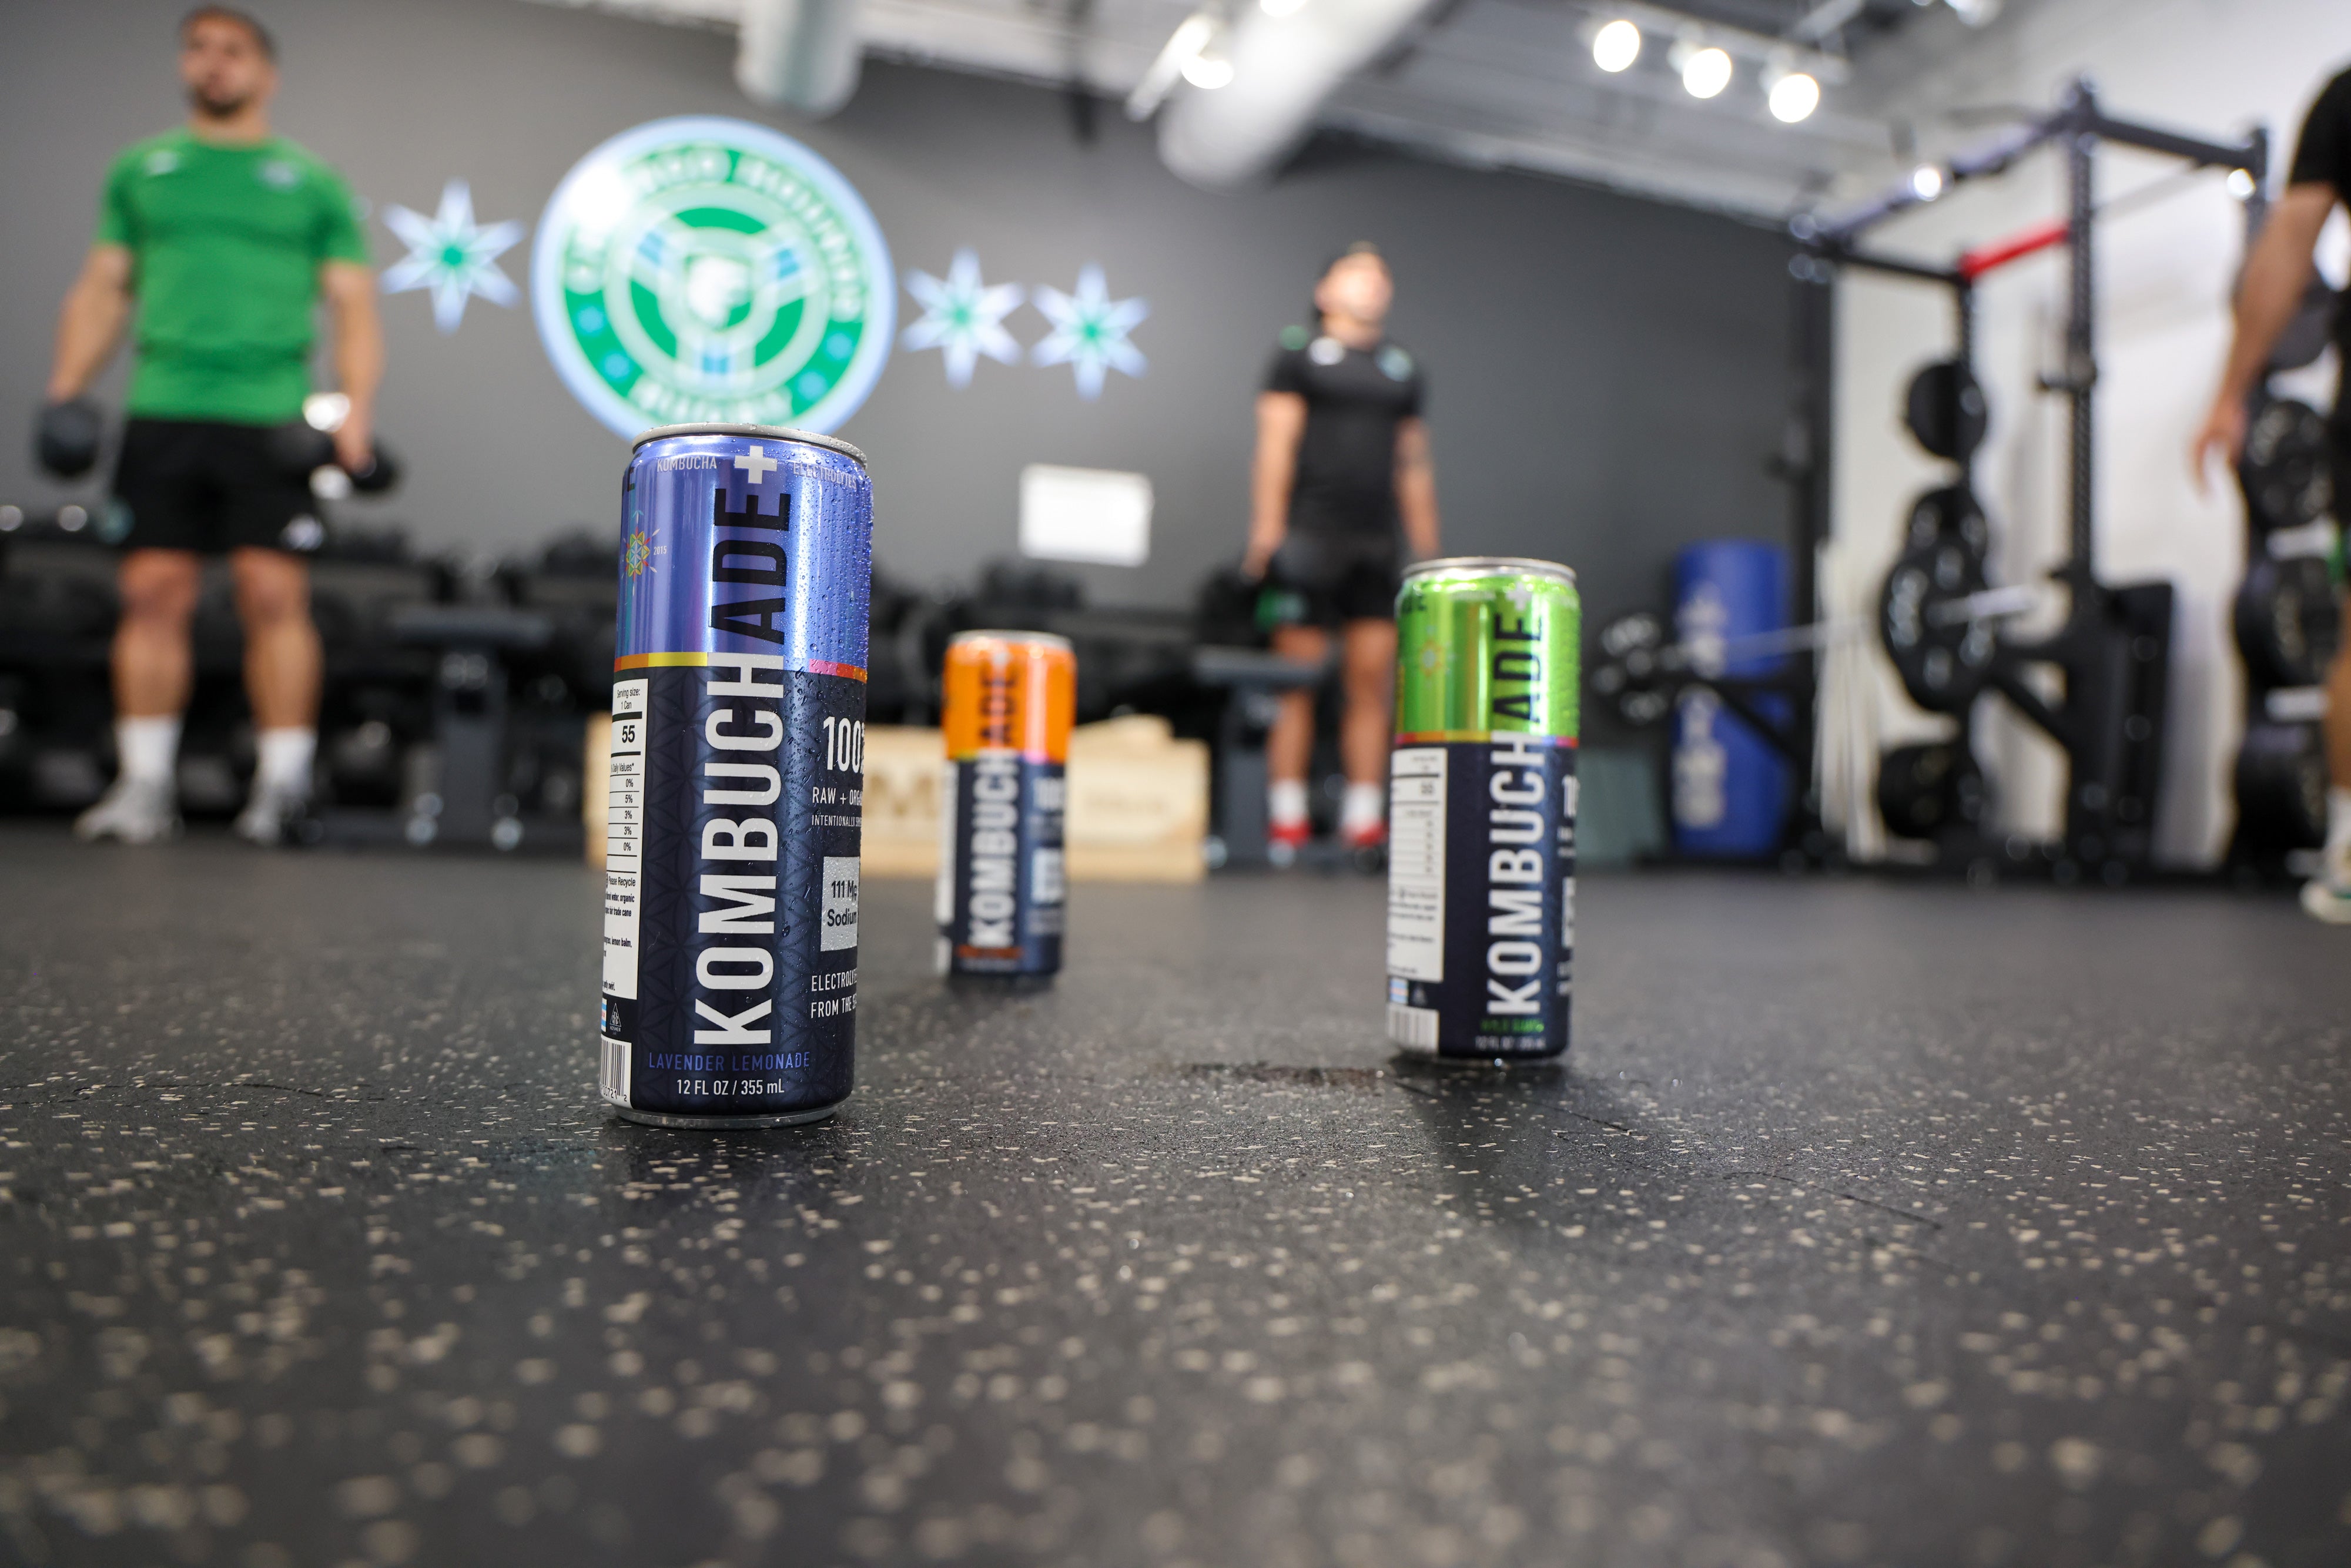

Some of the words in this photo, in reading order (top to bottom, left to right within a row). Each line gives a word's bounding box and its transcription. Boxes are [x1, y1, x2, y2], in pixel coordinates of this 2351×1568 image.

[657, 455, 717, 472] KOMBUCHA
[793, 461, 857, 489] ELECTROLYTES
[653, 545, 667, 555] 2015
[629, 687, 641, 696] size:
[624, 700, 632, 710] Can
[622, 725, 635, 743] 55
[625, 778, 634, 788] 0%
[625, 794, 633, 803] 5%
[812, 786, 836, 805] RAW
[840, 793, 847, 805] +
[624, 810, 632, 819] 3%
[812, 815, 855, 827] INTENTIONALLY
[624, 826, 632, 835] 3%
[623, 842, 631, 851] 0%
[618, 876, 636, 888] Recycle
[831, 880, 845, 899] 111
[619, 893, 635, 904] organic
[622, 909, 632, 917] cane
[811, 999, 839, 1018] FROM
[841, 996, 852, 1013] THE
[649, 1052, 725, 1071] LAVENDER
[732, 1051, 811, 1071] LEMONADE
[677, 1079, 691, 1094] 12
[694, 1080, 709, 1095] FL
[713, 1080, 729, 1095] OZ
[732, 1080, 738, 1095] /
[741, 1079, 763, 1095] 355
[766, 1078, 785, 1094] mL
